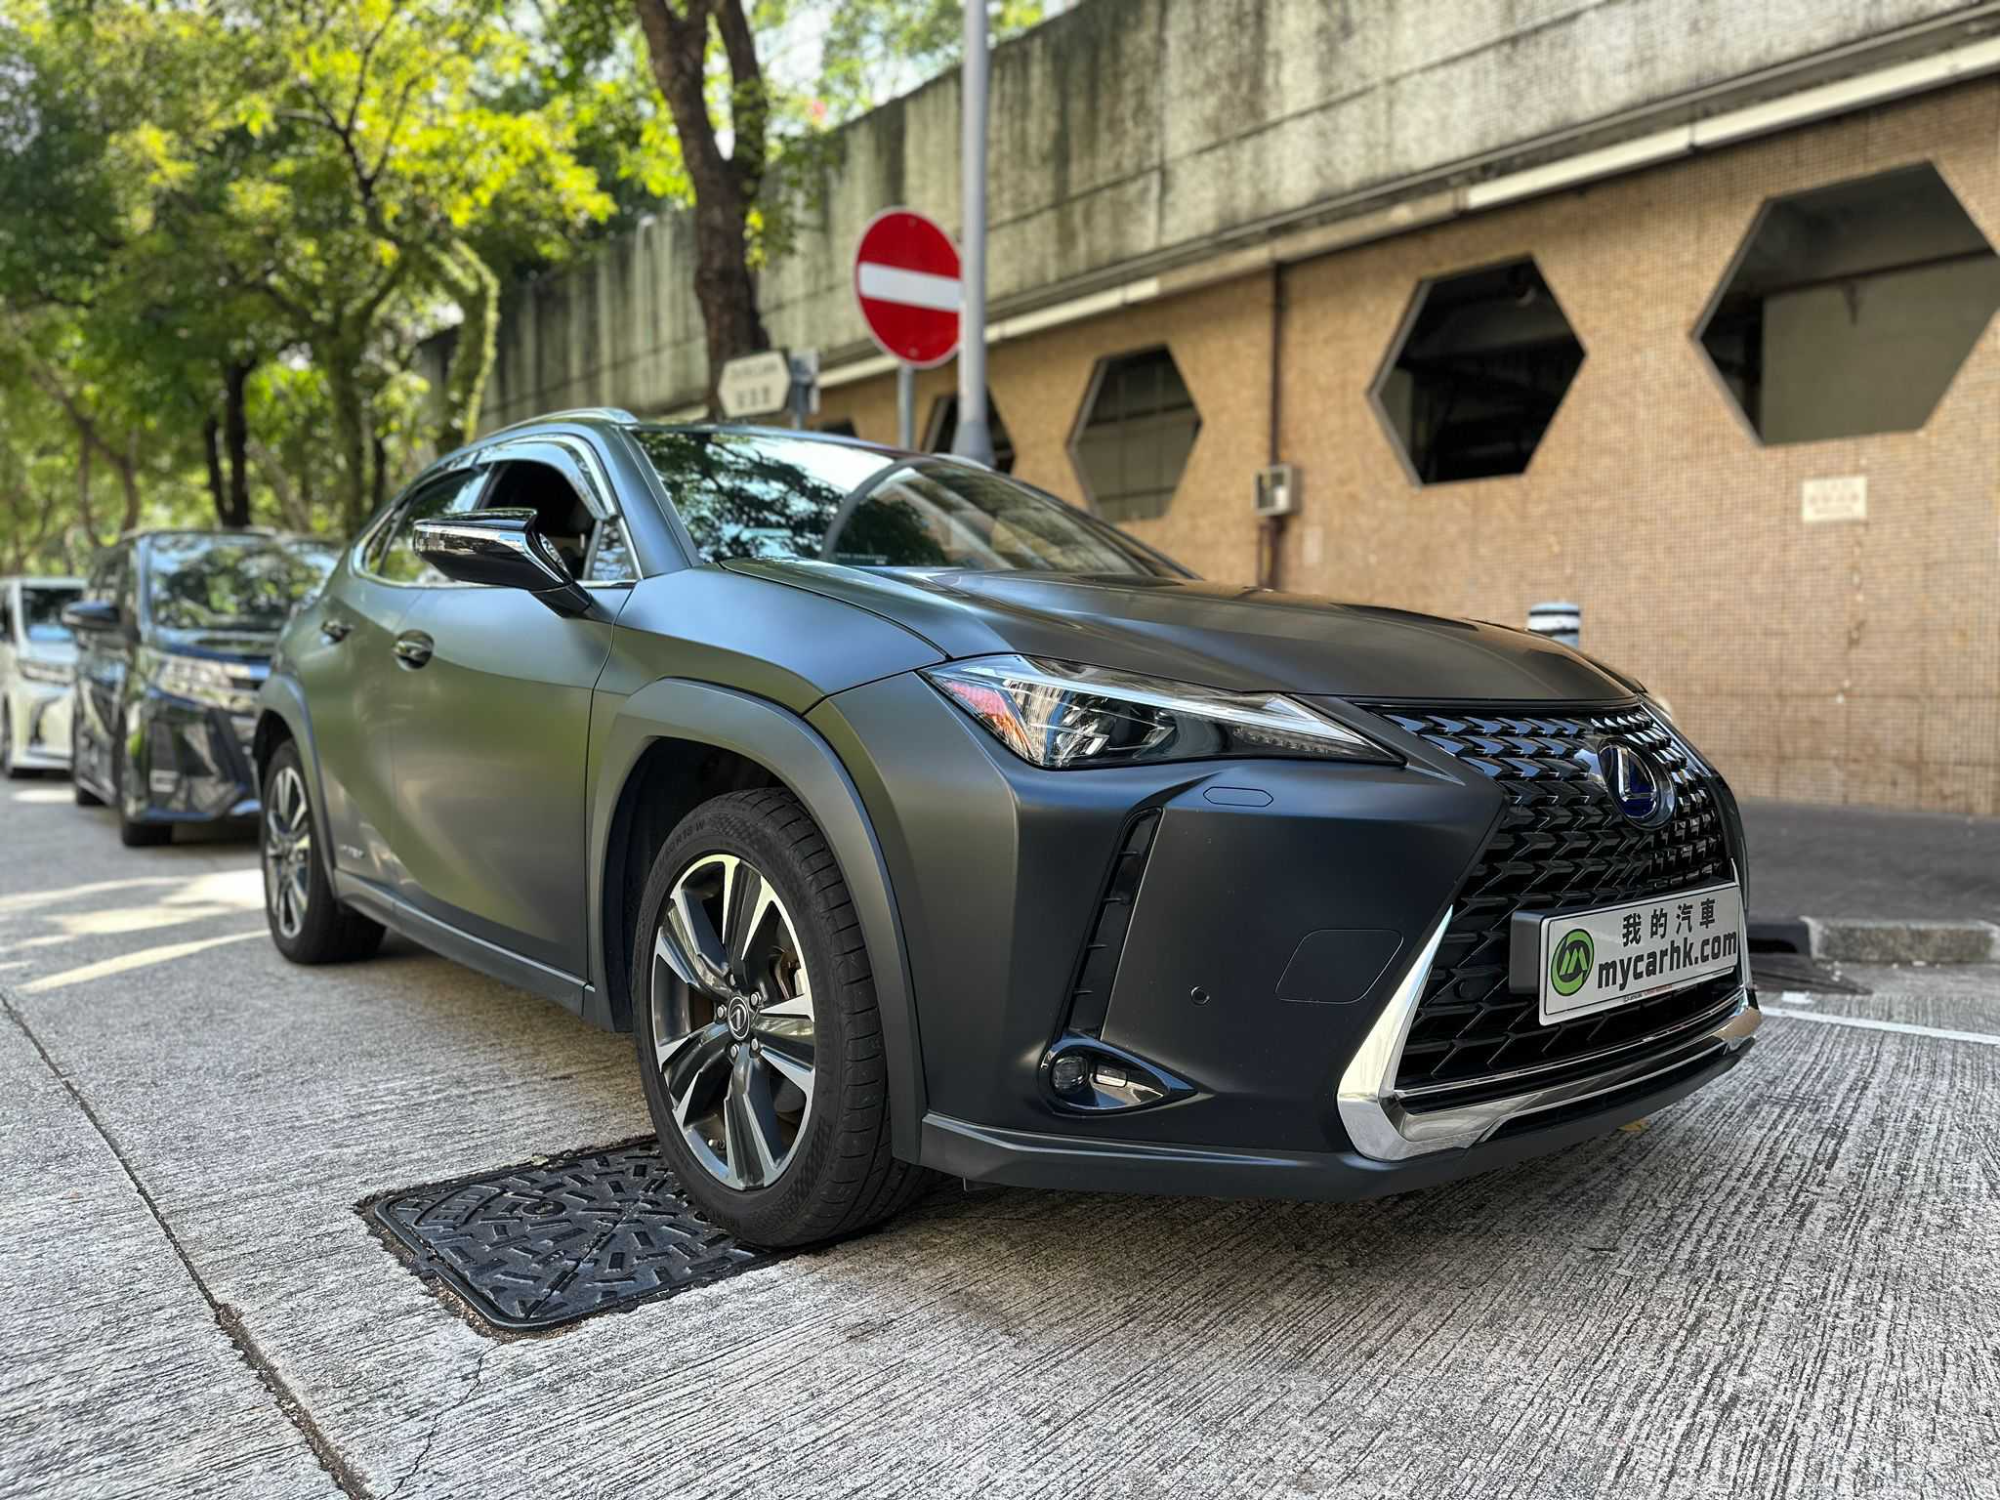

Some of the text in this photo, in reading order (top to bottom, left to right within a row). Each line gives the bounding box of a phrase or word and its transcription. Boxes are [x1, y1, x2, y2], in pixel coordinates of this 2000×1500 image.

[1622, 898, 1716, 948] 我的汽車
[1597, 931, 1737, 991] mycarhk.com
